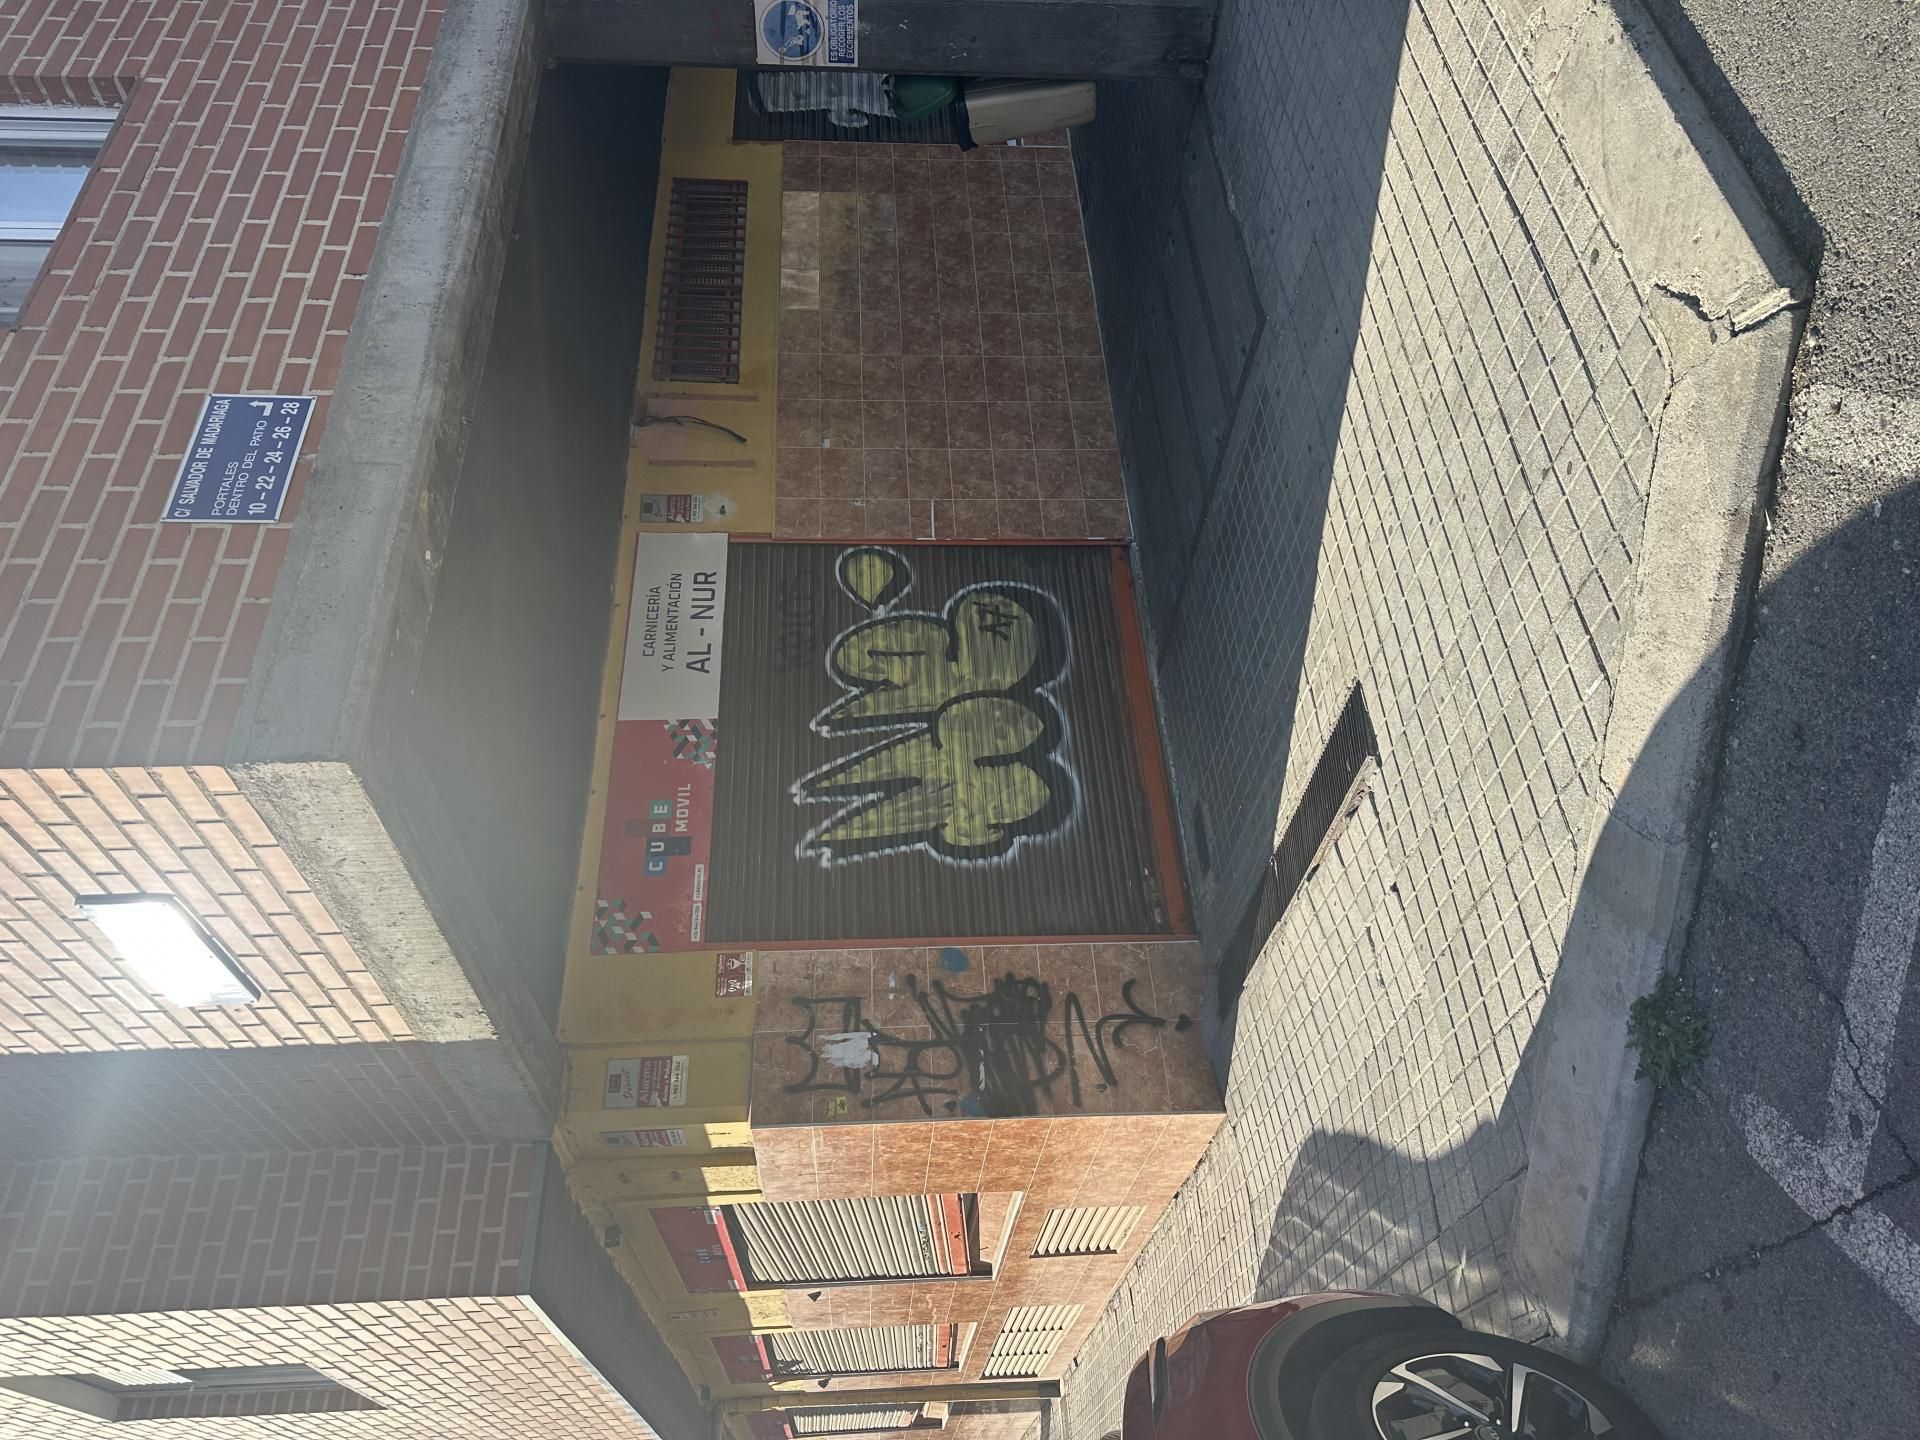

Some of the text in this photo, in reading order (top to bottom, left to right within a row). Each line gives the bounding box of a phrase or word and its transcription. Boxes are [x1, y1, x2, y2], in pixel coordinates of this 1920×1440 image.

[831, 52, 837, 60] ES
[281, 403, 300, 414] 28
[272, 427, 292, 439] 26
[174, 399, 231, 517] C/ SALVADOR DE MADARIAGA
[226, 421, 267, 515] DENTRO DEL PATIO
[264, 451, 284, 463] 24
[212, 462, 238, 516] PORTALES
[256, 476, 275, 489] 22
[248, 503, 267, 515] 10
[661, 573, 682, 660] ALIMENTACIÓN
[690, 571, 717, 620] NUR
[642, 586, 661, 657] CARNICERÍA
[686, 643, 711, 673] AL
[676, 784, 691, 832] MOVIL
[648, 804, 668, 872] CUBE
[640, 1061, 651, 1102] Alarma
